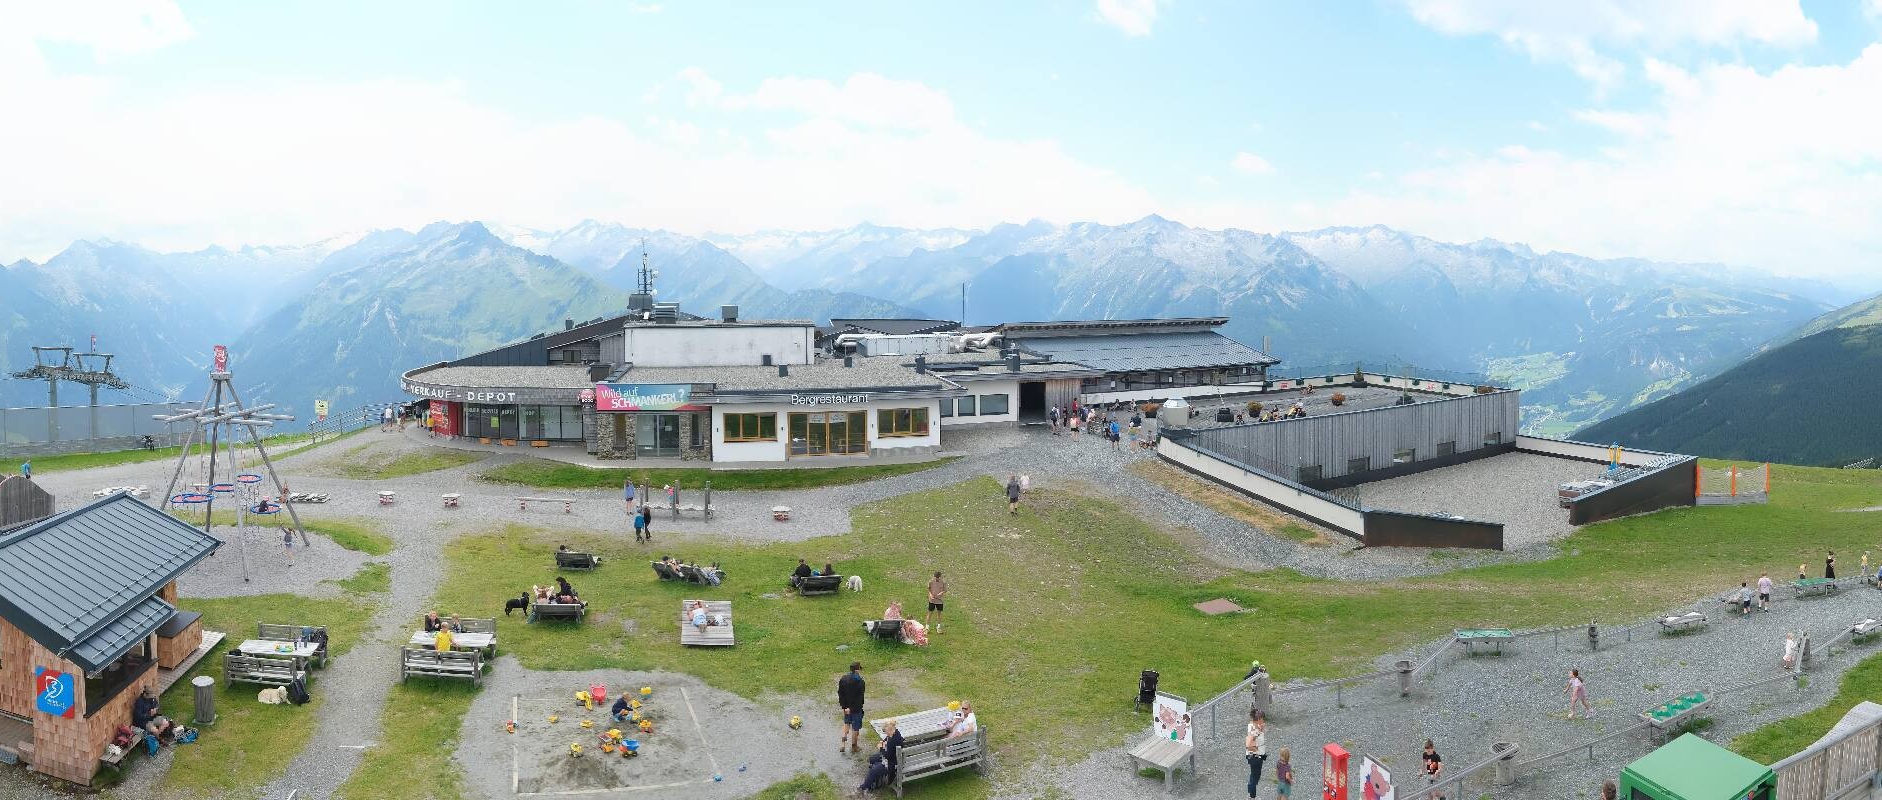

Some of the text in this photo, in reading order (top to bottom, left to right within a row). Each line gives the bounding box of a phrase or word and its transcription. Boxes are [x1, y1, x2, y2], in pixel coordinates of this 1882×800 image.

[467, 391, 516, 402] DEPOT
[601, 386, 639, 400] Wild auf
[791, 393, 869, 406] Bergrestaurant
